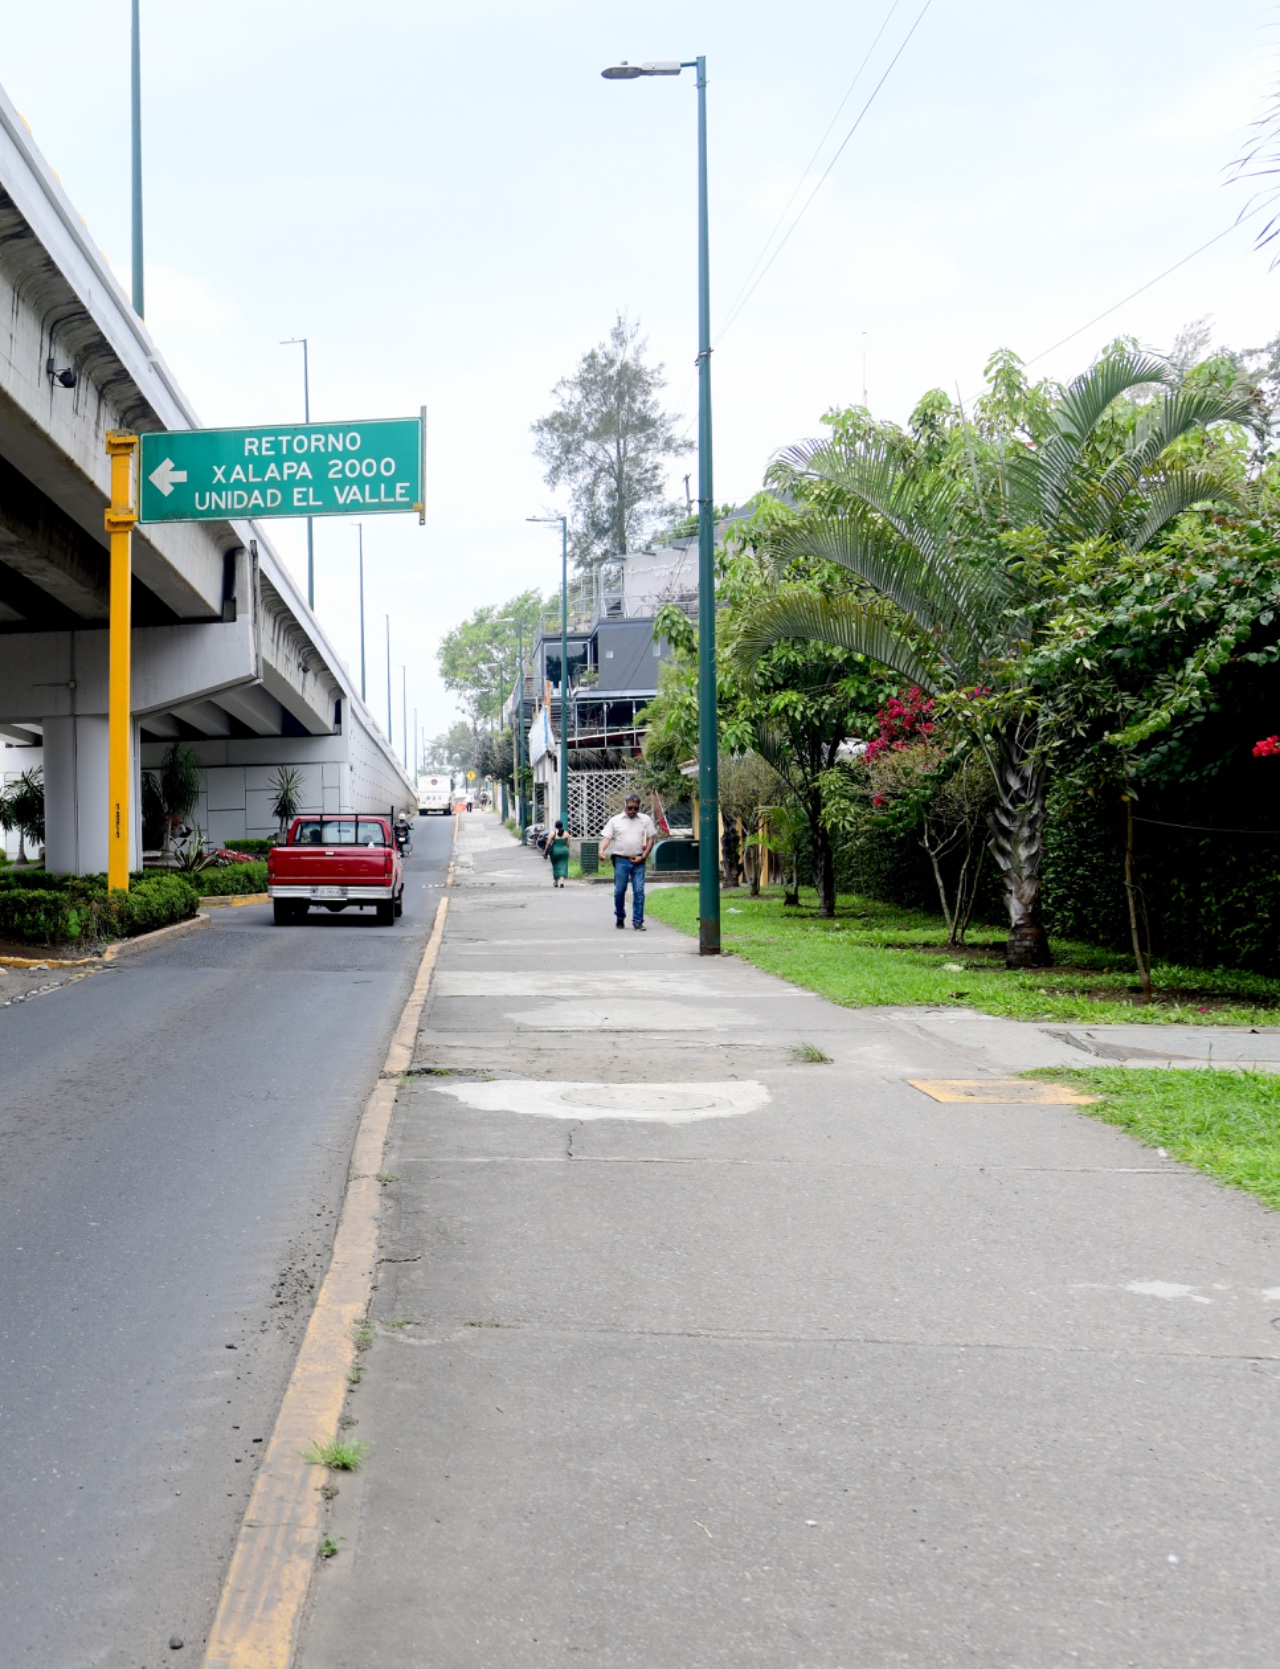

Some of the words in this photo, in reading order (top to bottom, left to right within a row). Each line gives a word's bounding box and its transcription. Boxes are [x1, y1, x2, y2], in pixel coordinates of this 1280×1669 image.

[244, 432, 361, 456] RETORNO
[212, 461, 313, 484] XALAPA
[328, 457, 396, 479] 2000
[194, 488, 282, 511] UNIDAD
[293, 487, 323, 507] EL
[333, 482, 410, 505] VALLE
